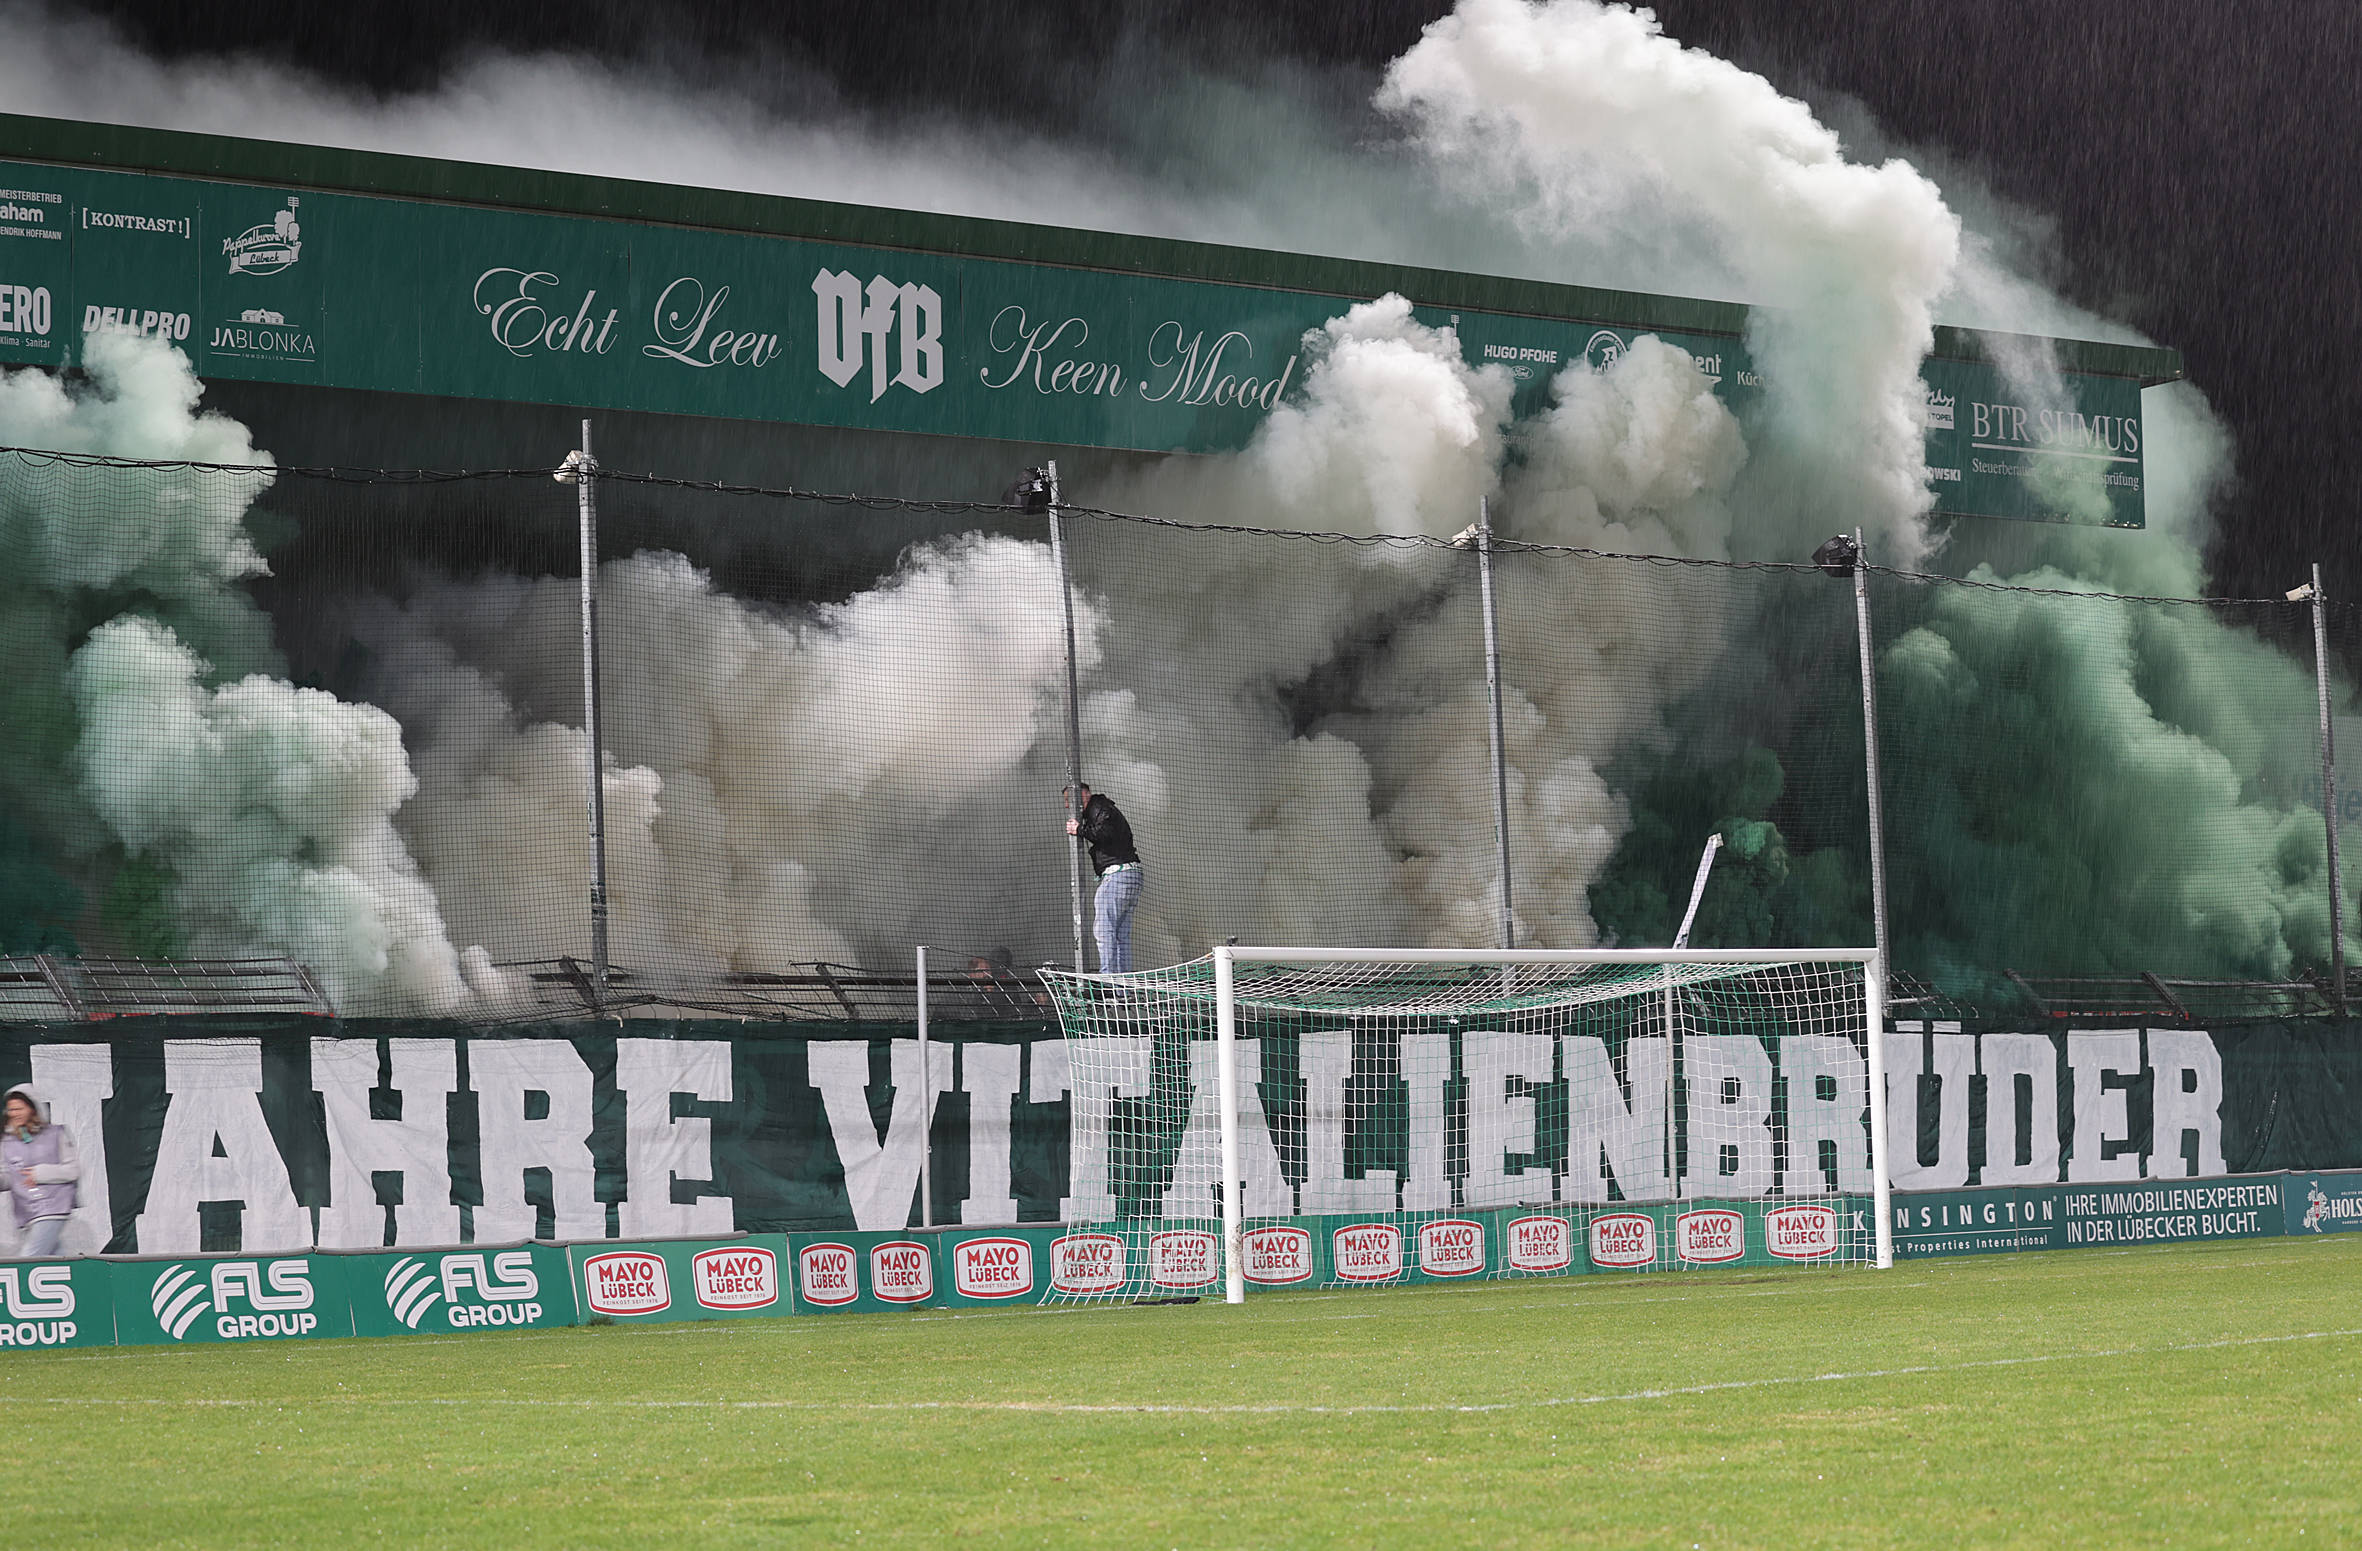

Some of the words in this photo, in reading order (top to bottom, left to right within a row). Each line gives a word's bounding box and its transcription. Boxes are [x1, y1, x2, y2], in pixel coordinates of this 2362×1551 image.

[0, 226, 25, 237] ENDRIK
[26, 228, 62, 240] HOFFMANN
[249, 254, 280, 264] Lübeck
[82, 305, 191, 341] DELLPRO
[474, 268, 620, 358] Echt
[642, 277, 782, 368] Leev
[210, 327, 316, 355] JABLONKA
[811, 267, 944, 404] VfB
[242, 353, 285, 361] IMMOBILIEN
[980, 305, 1127, 395] Keen
[1139, 321, 1298, 410] Mood
[1484, 344, 1517, 360] HUGO
[1520, 348, 1558, 364] PFOHE
[1688, 354, 1722, 374] ent
[1971, 402, 2032, 442] BTR
[2039, 409, 2139, 453] SUMUS
[807, 1020, 2228, 1232] VITALIENBRÜDER
[2066, 1194, 2098, 1217] IHRE
[2101, 1184, 2278, 1215] IMMOBILIENEXPERTEN
[1777, 1214, 1825, 1232] MAYO
[1853, 1201, 2053, 1230] KNSINGTON
[1519, 1224, 1560, 1242] MAYO
[1600, 1221, 1645, 1239] MAYO
[1689, 1217, 1732, 1236] MAYO
[2067, 1221, 2082, 1243] IN
[2086, 1219, 2114, 1242] DER
[2117, 1215, 2198, 1241] LÜBECKER
[2201, 1211, 2261, 1235] BUCHT.
[1252, 1235, 1300, 1255] MAYO
[1344, 1232, 1390, 1252] MAYO
[1430, 1228, 1474, 1248] MAYO
[1600, 1239, 1645, 1254] LÜBECK
[1689, 1234, 1732, 1250] LÜBECK
[1778, 1229, 1826, 1245] LÜBECK
[1907, 1240, 1970, 1253] Properties
[1976, 1234, 2048, 1248] International
[967, 1246, 1019, 1267] MAYO
[1062, 1243, 1113, 1262] MAYO
[1161, 1240, 1207, 1259] MAYO
[1346, 1250, 1390, 1266] LÜBECK
[1431, 1246, 1474, 1262] LÜBECK
[1519, 1241, 1560, 1257] LÜBECK
[707, 1257, 762, 1278] MAYO
[810, 1253, 847, 1273] MAYO
[880, 1251, 921, 1271] MAYO
[1064, 1262, 1113, 1278] LÜBECK
[1161, 1258, 1207, 1273] LÜBECK
[1252, 1253, 1300, 1270] LÜBECK
[440, 1251, 539, 1303] FLS
[598, 1262, 653, 1283] MAYO
[811, 1271, 847, 1289] LÜBECK
[881, 1270, 922, 1287] LÜBECK
[968, 1266, 1020, 1283] LÜBECK
[211, 1259, 314, 1313] FLS
[601, 1282, 656, 1299] LÜBECK
[709, 1277, 764, 1294] LÜBECK
[448, 1303, 543, 1328] GROUP
[217, 1313, 317, 1338] GROUP
